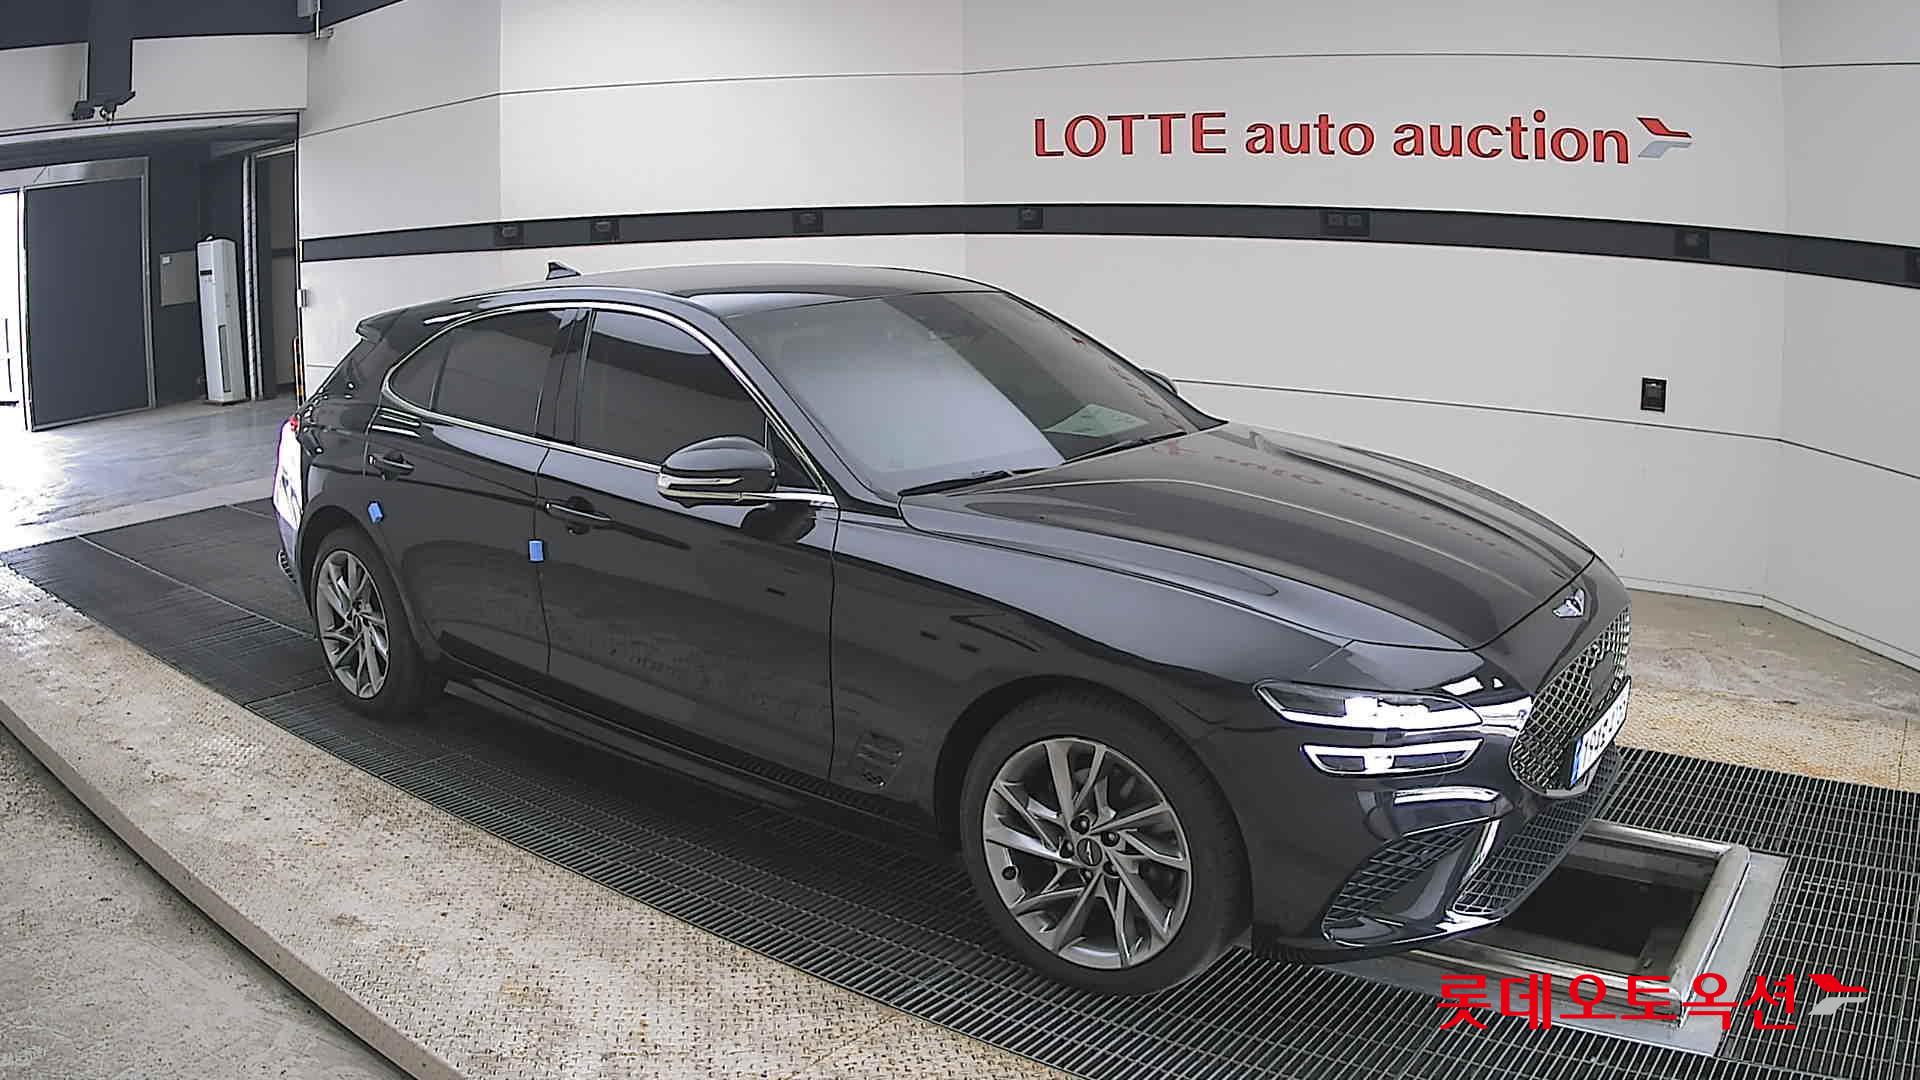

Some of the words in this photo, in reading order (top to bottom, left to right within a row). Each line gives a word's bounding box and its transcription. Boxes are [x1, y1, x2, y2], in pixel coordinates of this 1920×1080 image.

[1034, 112, 1227, 157] LOTTE
[1246, 113, 1375, 156] auto
[1393, 109, 1630, 164] auction
